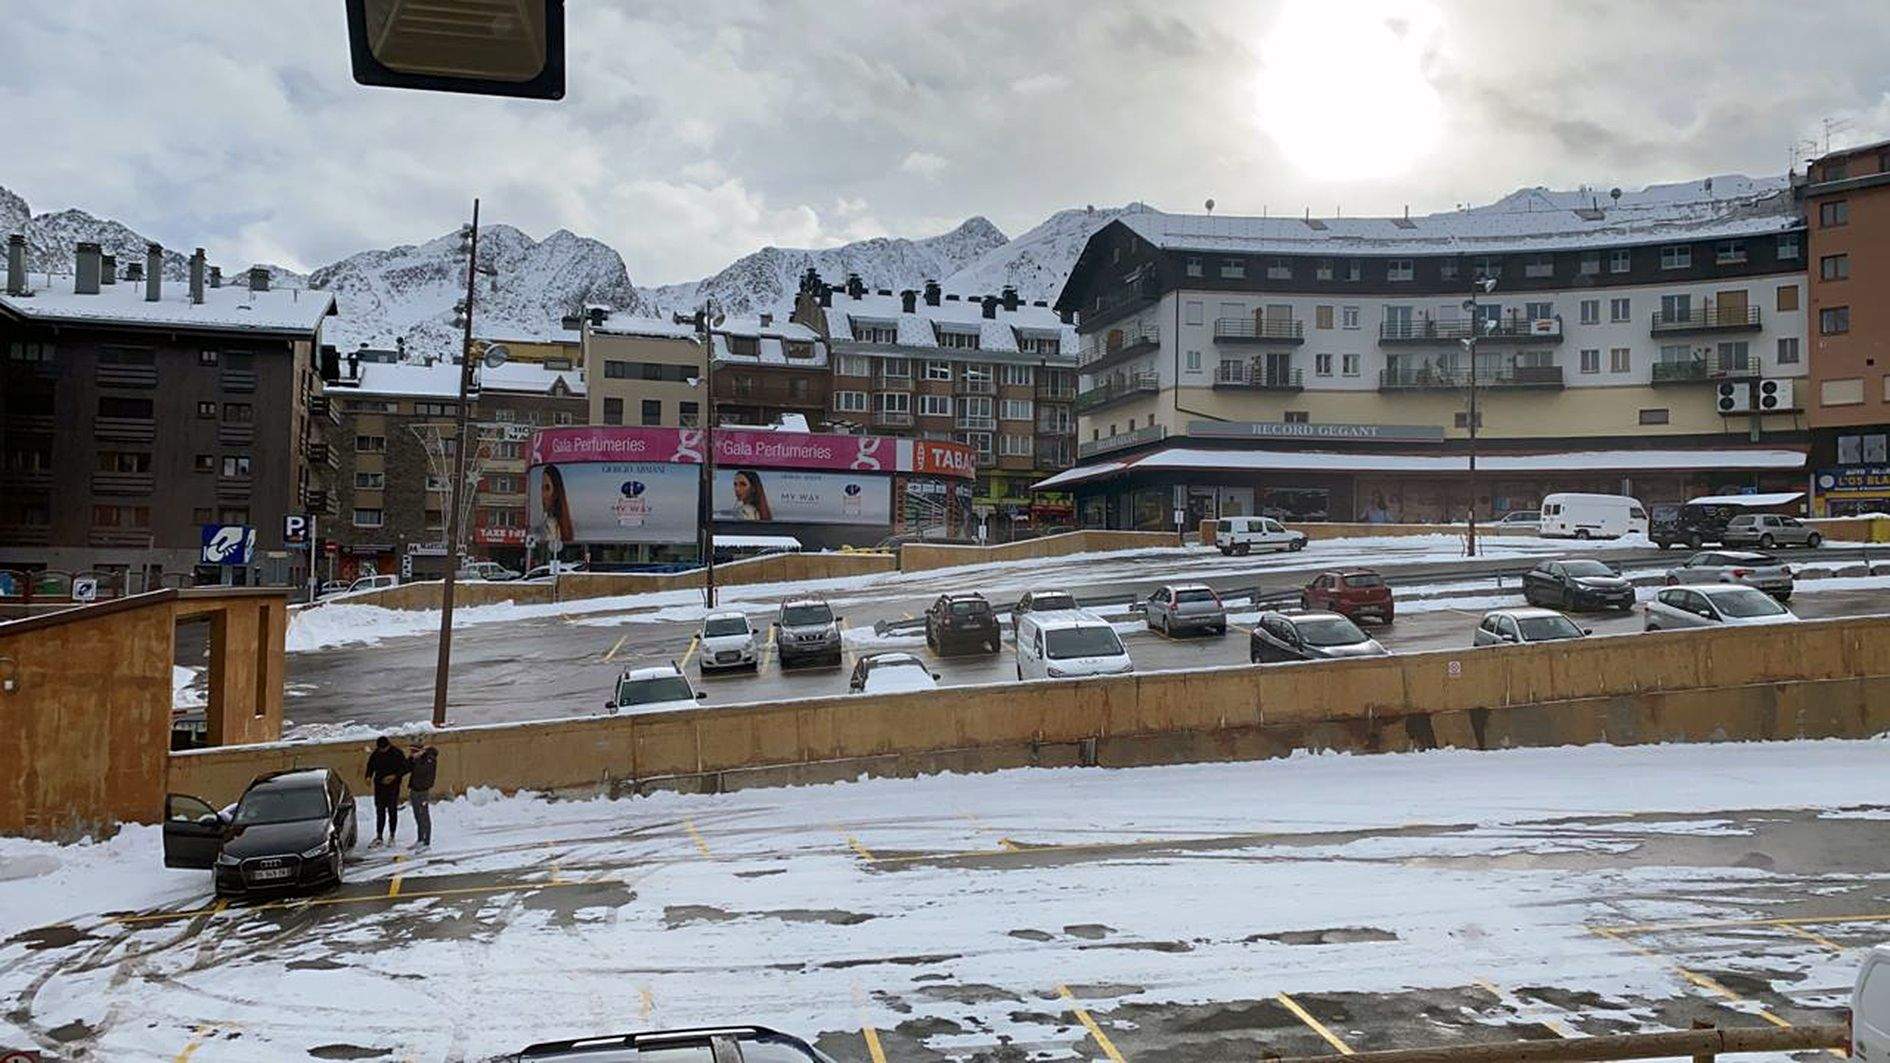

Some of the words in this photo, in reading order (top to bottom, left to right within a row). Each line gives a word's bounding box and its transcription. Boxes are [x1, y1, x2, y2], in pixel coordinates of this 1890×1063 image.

[1252, 423, 1314, 435] RECORD
[1318, 424, 1379, 437] GEGANT
[552, 438, 572, 453] Gala
[574, 437, 646, 452] Perfumeries
[723, 440, 752, 456] Gala
[755, 441, 832, 460] Perfumeries
[286, 515, 306, 537] P
